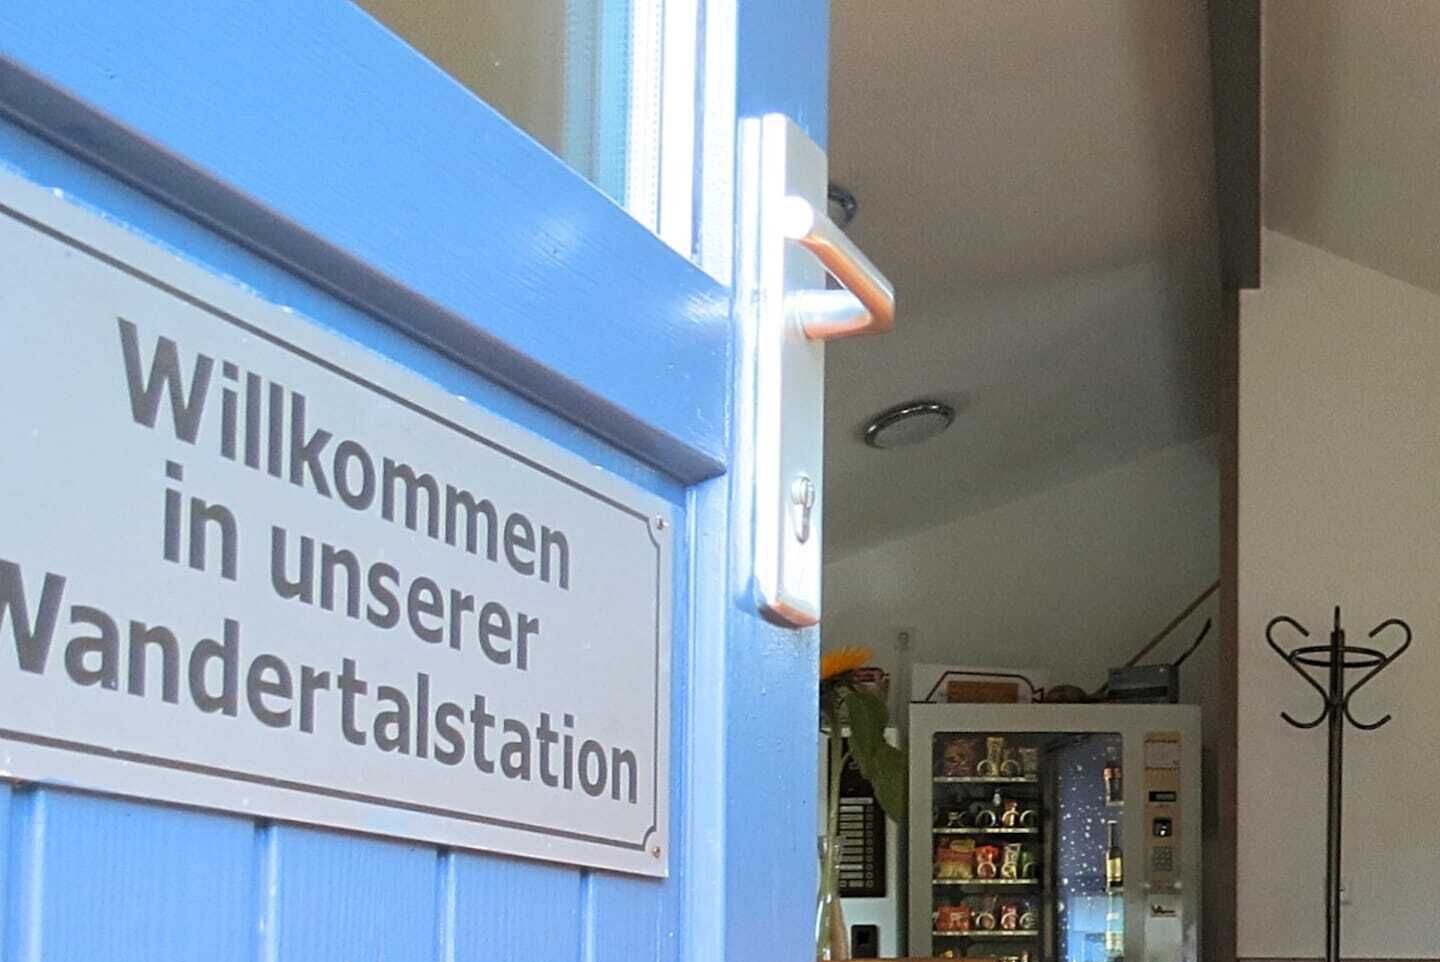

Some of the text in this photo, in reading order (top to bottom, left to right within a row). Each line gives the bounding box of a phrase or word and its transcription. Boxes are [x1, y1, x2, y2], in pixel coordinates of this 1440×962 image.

[116, 315, 571, 591] Willkommen
[162, 459, 541, 671] in unserer
[0, 557, 639, 805] Wandertalstation
